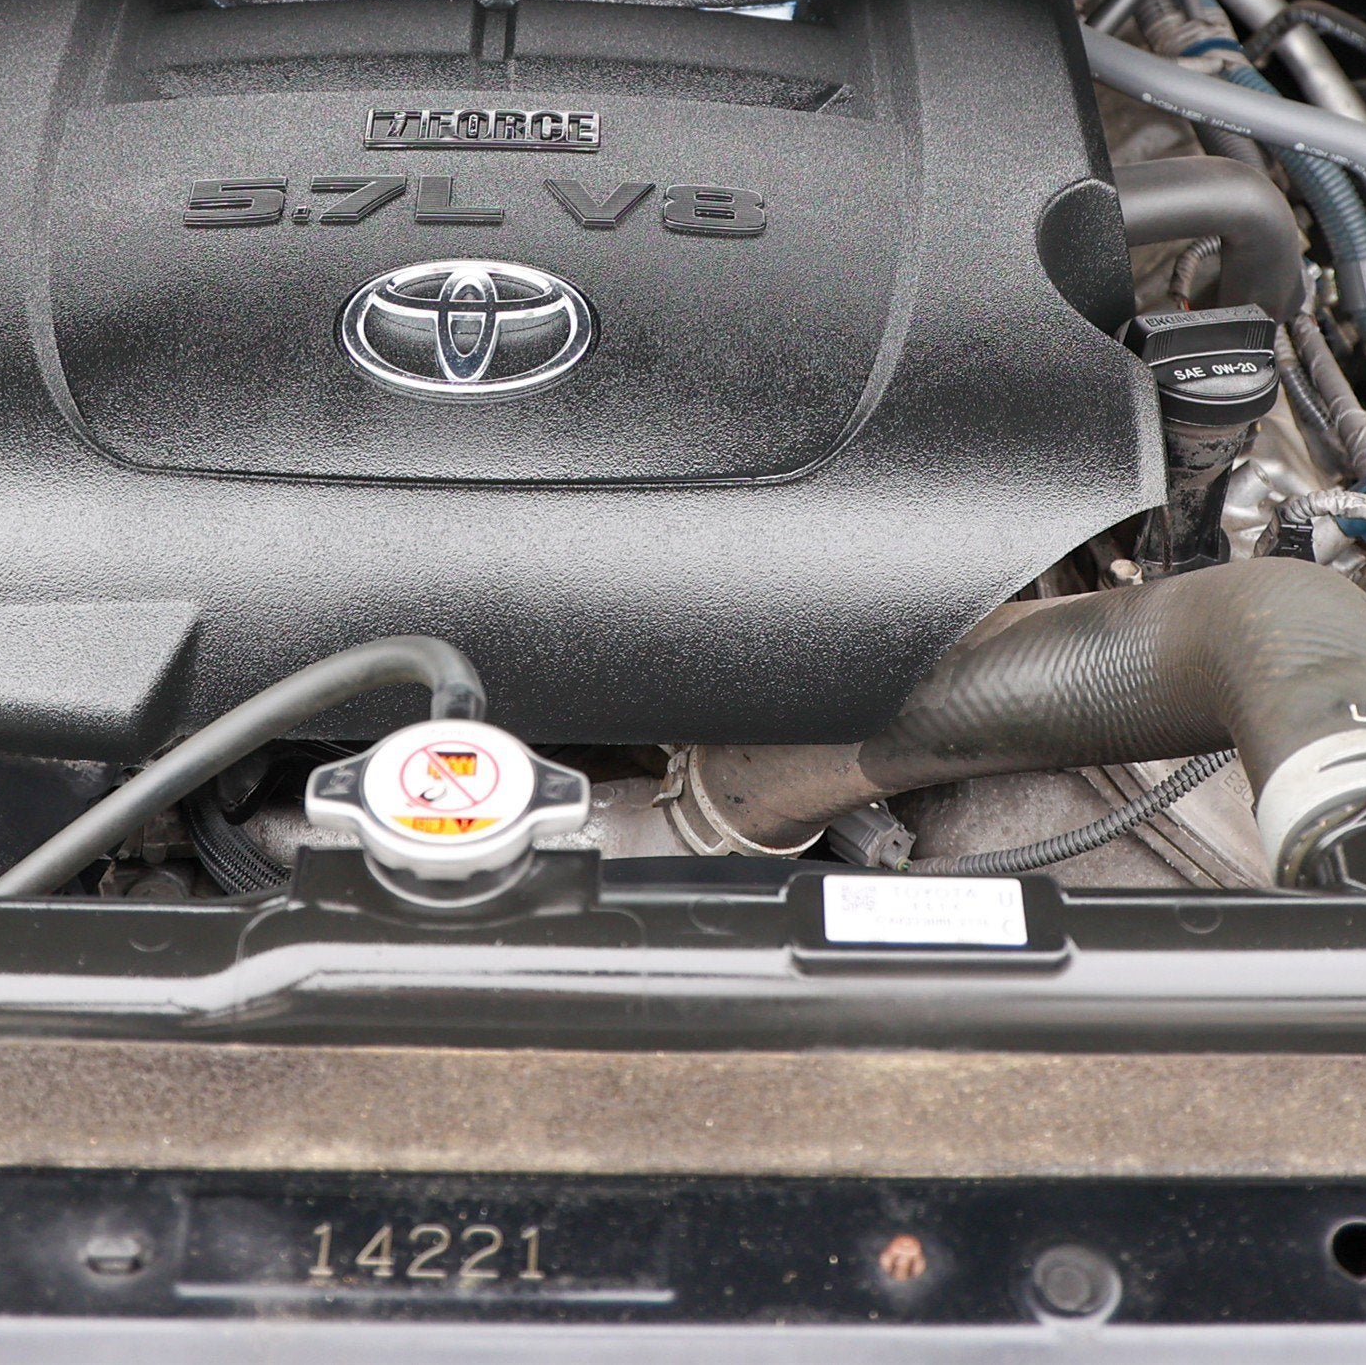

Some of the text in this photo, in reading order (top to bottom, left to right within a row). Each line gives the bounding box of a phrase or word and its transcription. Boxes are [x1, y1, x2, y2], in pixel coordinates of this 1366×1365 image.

[184, 176, 766, 234] 5.7L V8
[1173, 362, 1258, 381] SAE 0W-20
[308, 1221, 546, 1280] 14221
